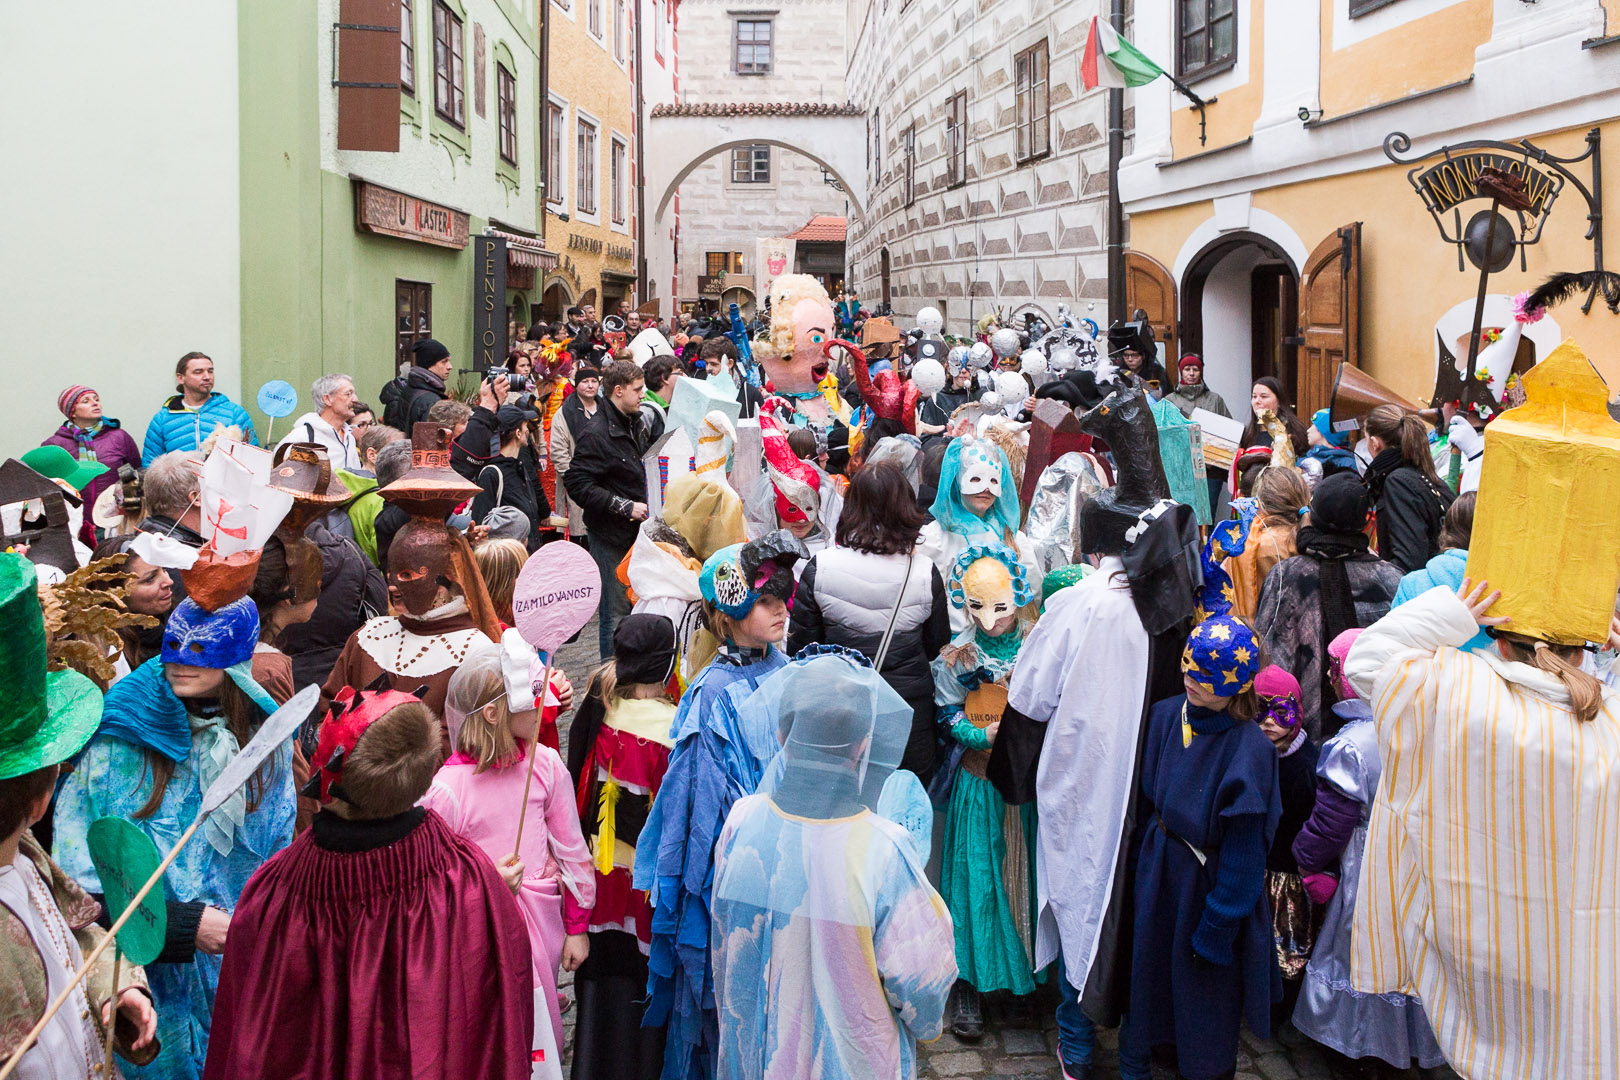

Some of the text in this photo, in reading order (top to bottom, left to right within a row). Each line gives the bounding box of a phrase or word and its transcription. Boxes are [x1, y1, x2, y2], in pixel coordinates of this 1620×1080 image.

[399, 197, 407, 226] U
[567, 232, 604, 254] PENSION
[482, 241, 496, 366] PENSION
